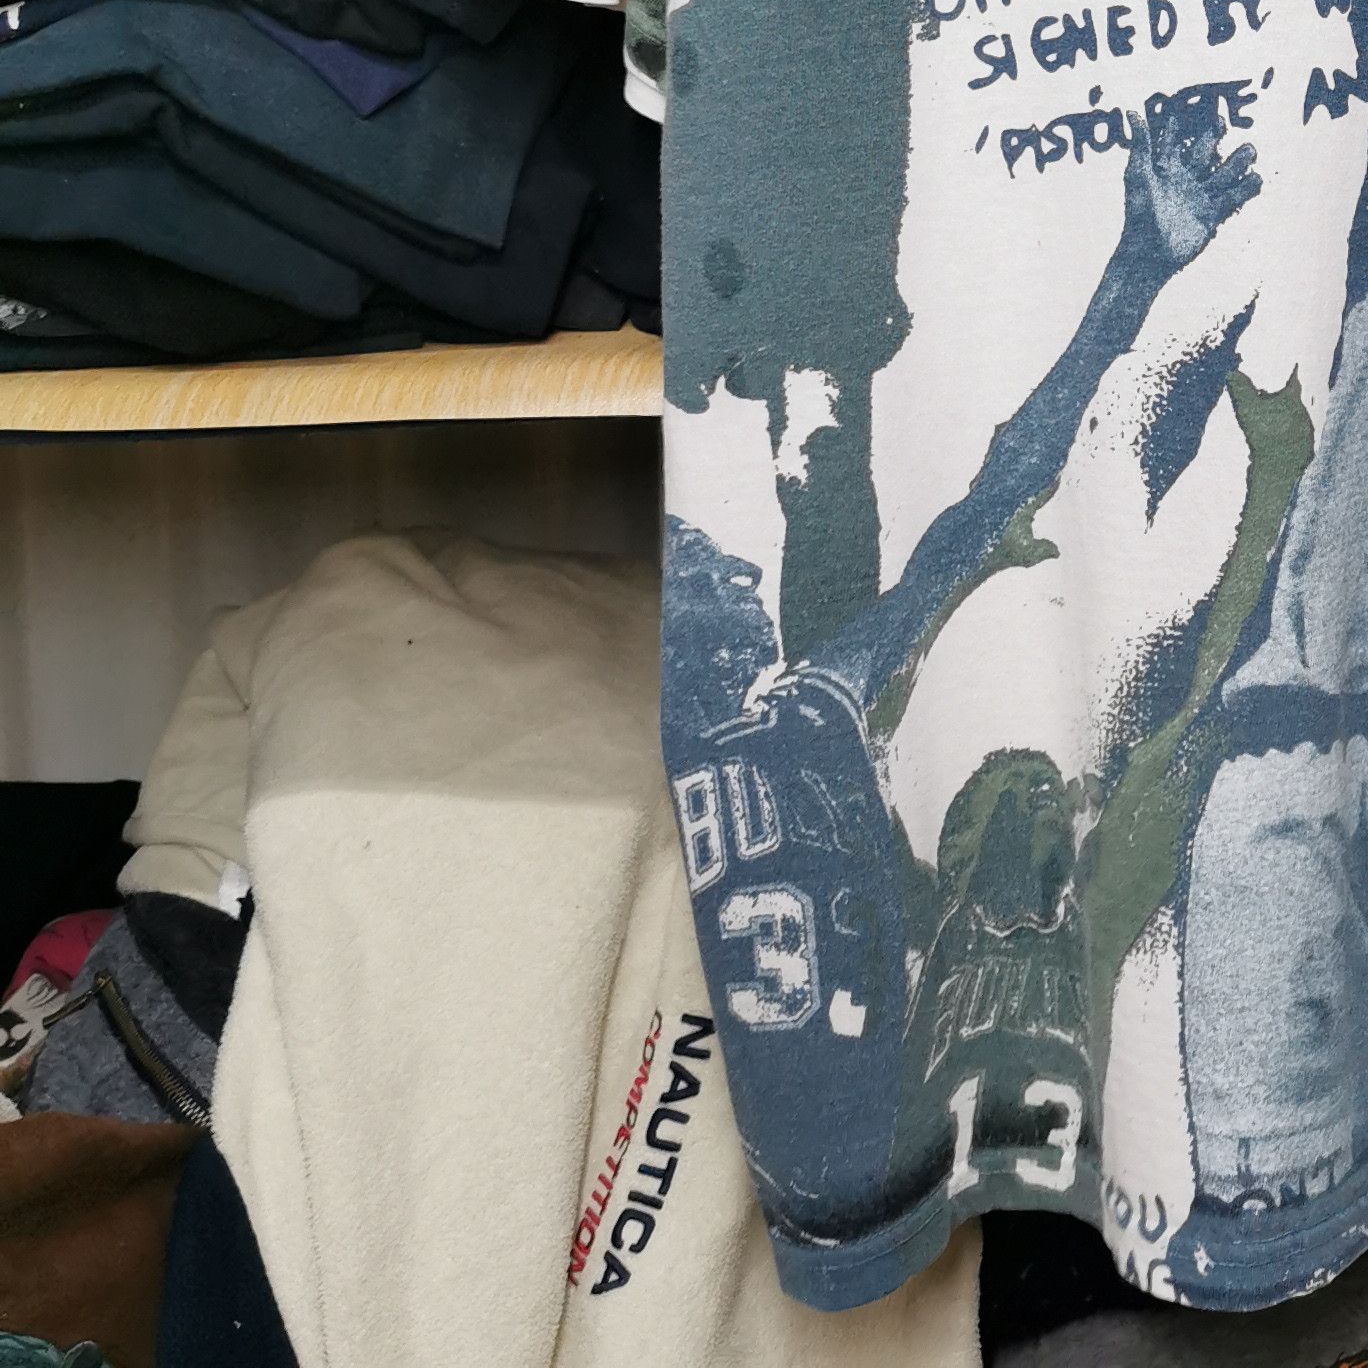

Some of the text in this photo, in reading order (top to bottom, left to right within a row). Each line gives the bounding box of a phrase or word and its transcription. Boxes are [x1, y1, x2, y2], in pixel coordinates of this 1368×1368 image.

[567, 1008, 663, 1289] COMPETITION
[590, 1013, 716, 1296] NAUTICA
[948, 1074, 1082, 1199] 13
